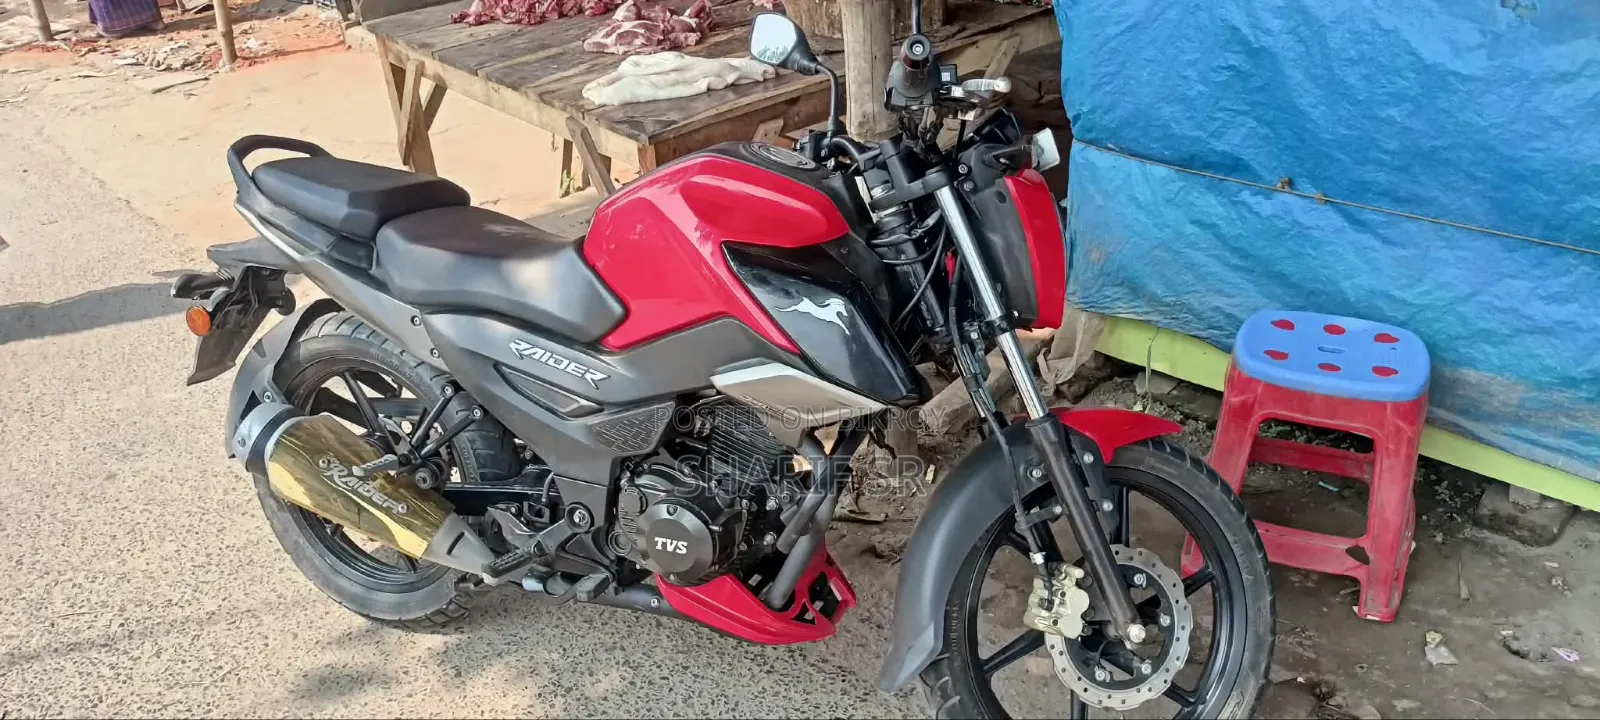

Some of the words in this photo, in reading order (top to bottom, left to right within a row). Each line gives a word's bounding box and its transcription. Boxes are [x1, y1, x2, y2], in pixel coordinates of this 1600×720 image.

[509, 339, 611, 390] RAIDER
[323, 462, 400, 514] RAIDER
[654, 536, 688, 555] TVS
